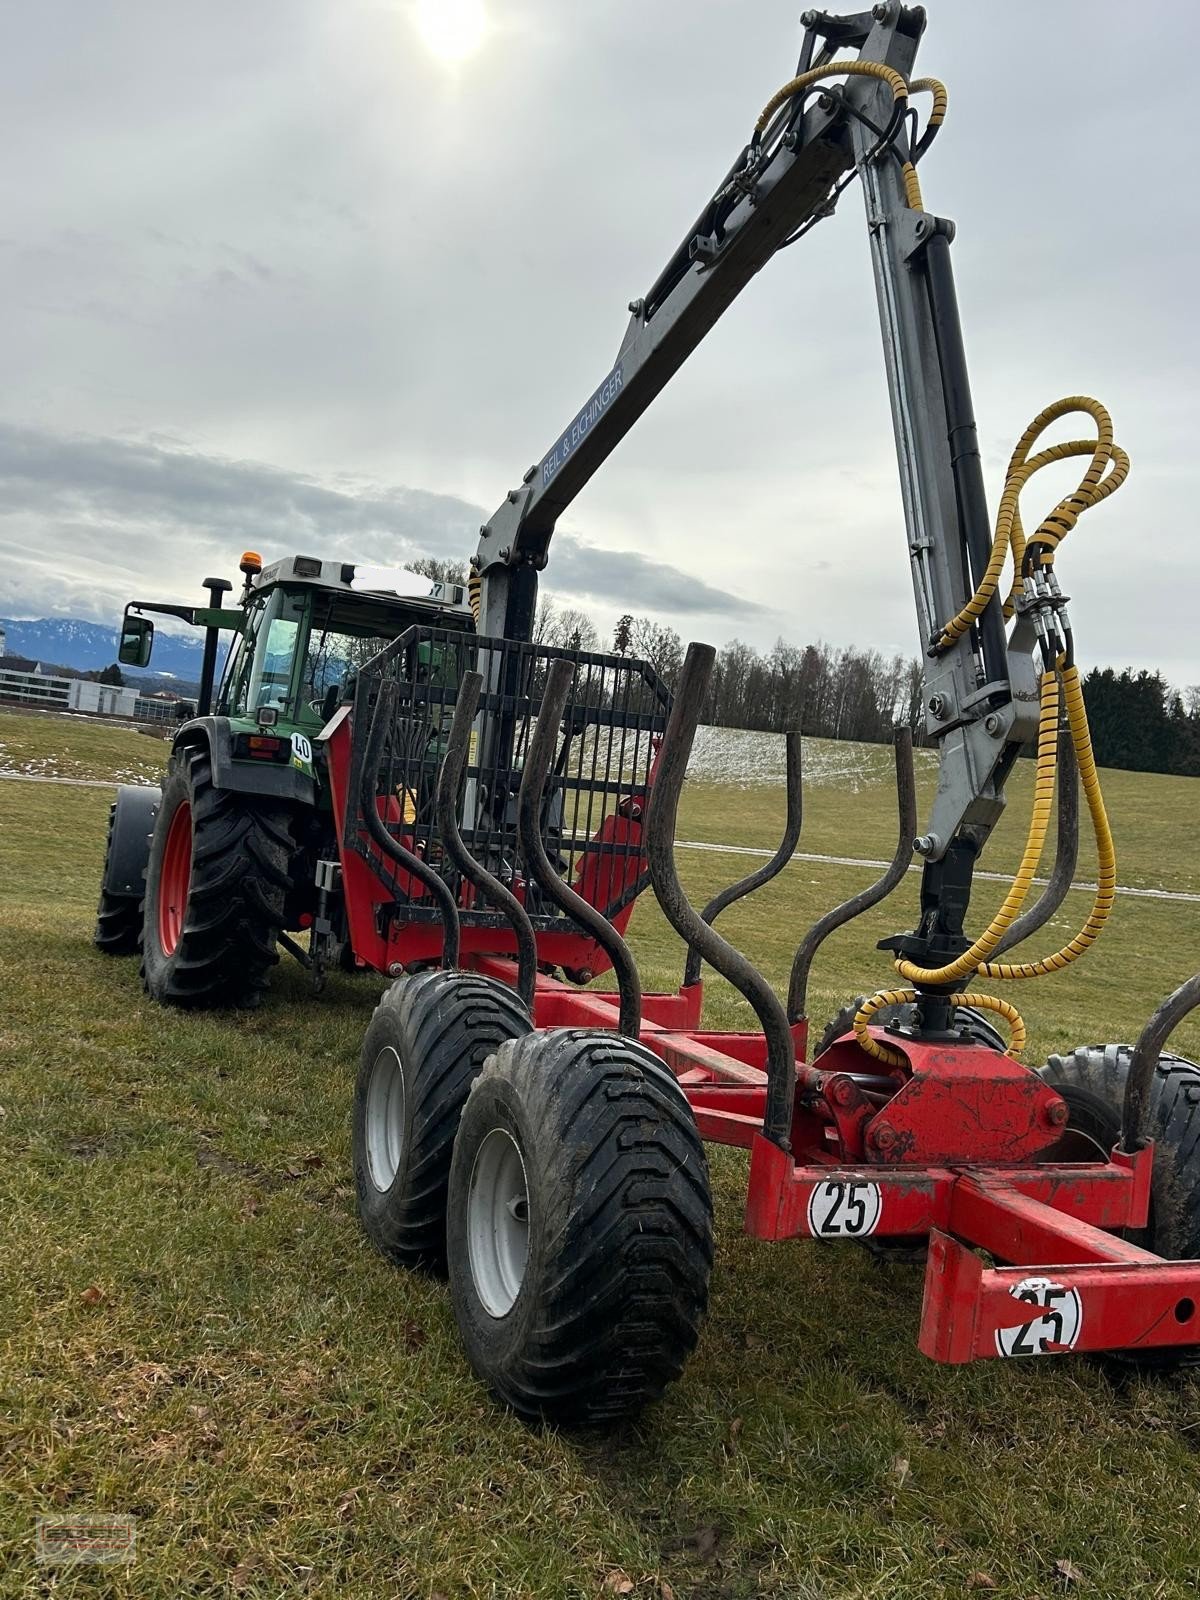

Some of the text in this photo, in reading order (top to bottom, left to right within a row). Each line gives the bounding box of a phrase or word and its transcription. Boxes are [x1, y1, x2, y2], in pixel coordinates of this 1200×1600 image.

[542, 370, 623, 483] REIL & EICHINGER
[295, 735, 309, 759] 40
[821, 1182, 869, 1233] 25
